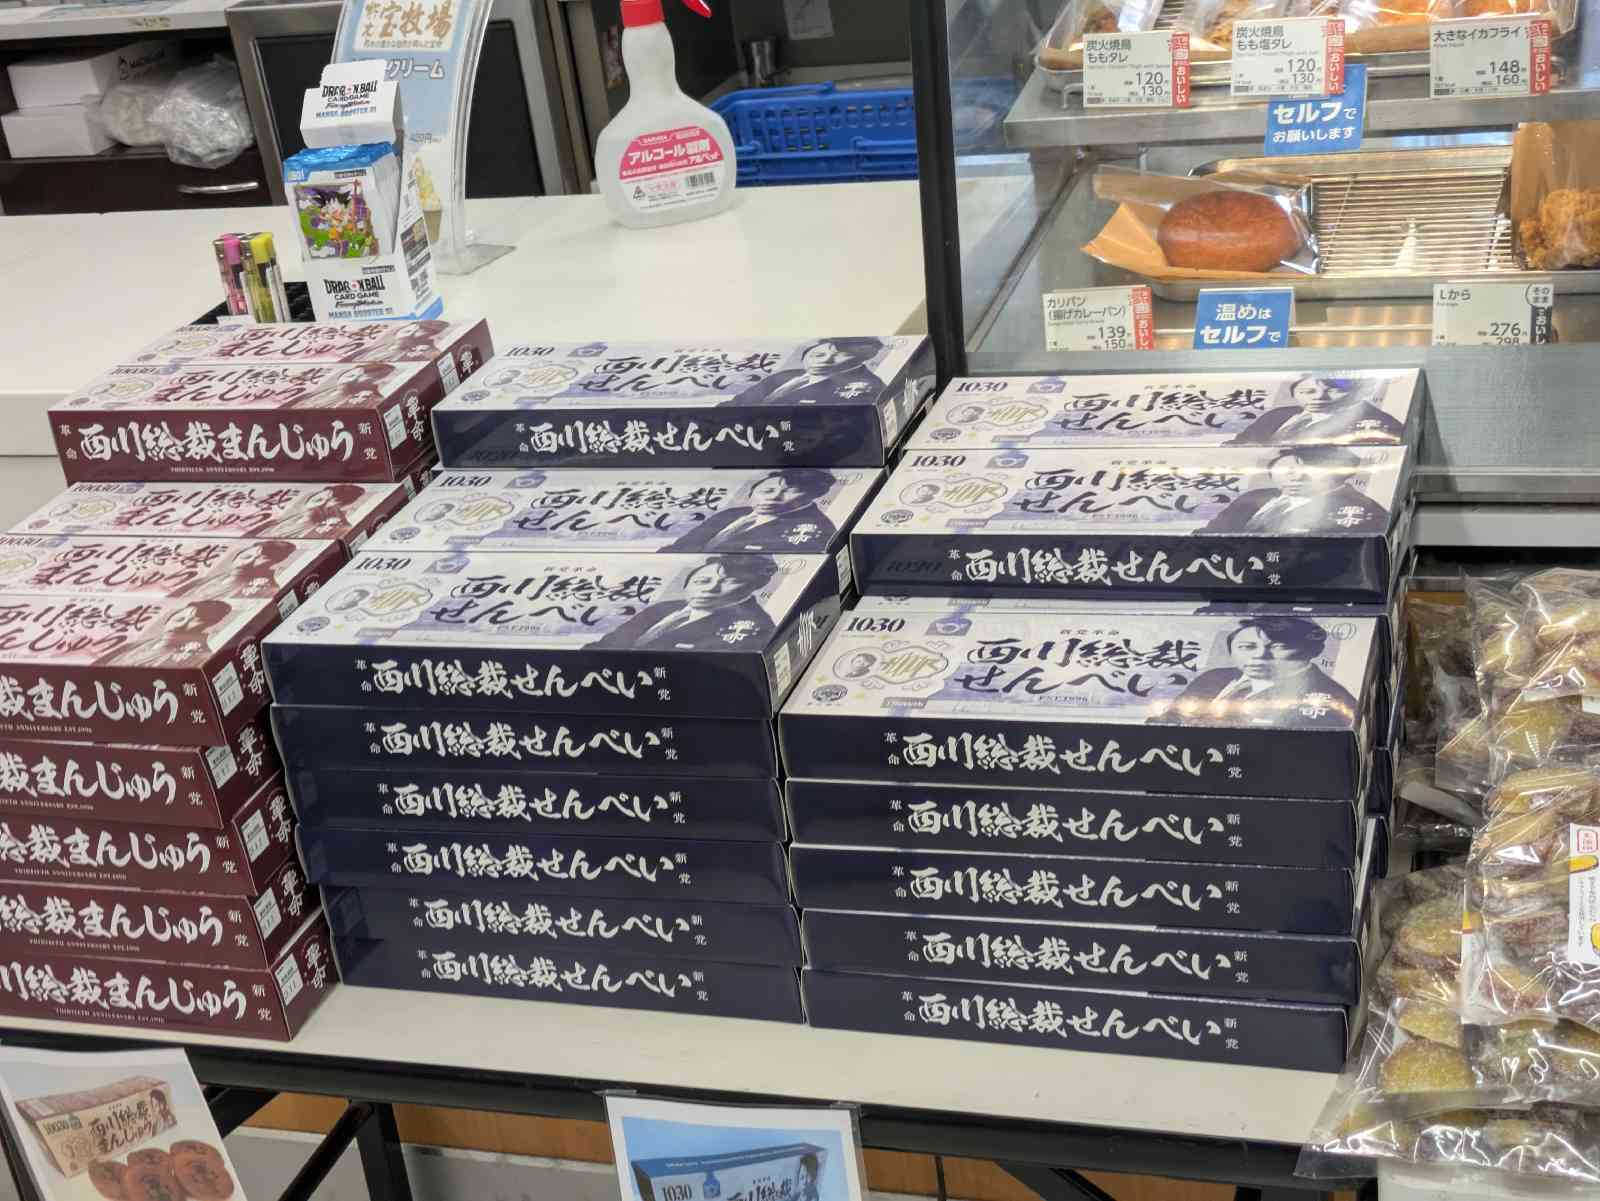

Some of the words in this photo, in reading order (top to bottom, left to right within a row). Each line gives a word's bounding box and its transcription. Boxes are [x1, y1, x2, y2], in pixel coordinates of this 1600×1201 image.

[1237, 39, 1292, 51] もも塩タレ
[1433, 26, 1521, 42] 大きなイカフライ
[1088, 52, 1129, 64] ももタレ
[1273, 101, 1358, 125] セルフで
[1272, 126, 1355, 143] お願いします
[1048, 295, 1088, 309] カリパン
[1440, 288, 1471, 301] Lから
[1216, 303, 1272, 321] 温めは
[1200, 325, 1281, 344] セルフで
[1490, 322, 1520, 337] 276
[578, 373, 762, 392] せんべい
[955, 381, 1009, 393] 1030
[1053, 411, 1257, 431] せんべい
[530, 420, 780, 455] 西川総裁せんべい
[911, 454, 968, 467] 1030
[440, 474, 493, 488] 1030
[1011, 490, 1232, 515] せんべい
[512, 510, 708, 532] せんべい
[353, 556, 412, 571] 1030
[965, 547, 1264, 585] 西川総裁せんべい
[430, 599, 638, 627] せんべい
[846, 616, 906, 633] 1030
[371, 658, 654, 700] 西川総裁せんべい
[954, 663, 1189, 698] せんべい
[381, 720, 661, 760] 西川総裁せんべい
[902, 731, 1224, 776] 西川総裁せんべい
[394, 782, 670, 822] 西川総裁せんべい
[908, 800, 1225, 845] 西川総裁せんべい
[402, 842, 675, 881] 西川総裁せんべい
[910, 866, 1222, 911] 西川総裁せんべい
[424, 898, 691, 942] 西川総裁せんべい
[922, 931, 1232, 981] 西川総裁せんべい
[432, 951, 692, 998] 西川総裁せんべい
[918, 993, 1222, 1046] 西川総裁せんべい
[661, 1184, 693, 1201] 1030
